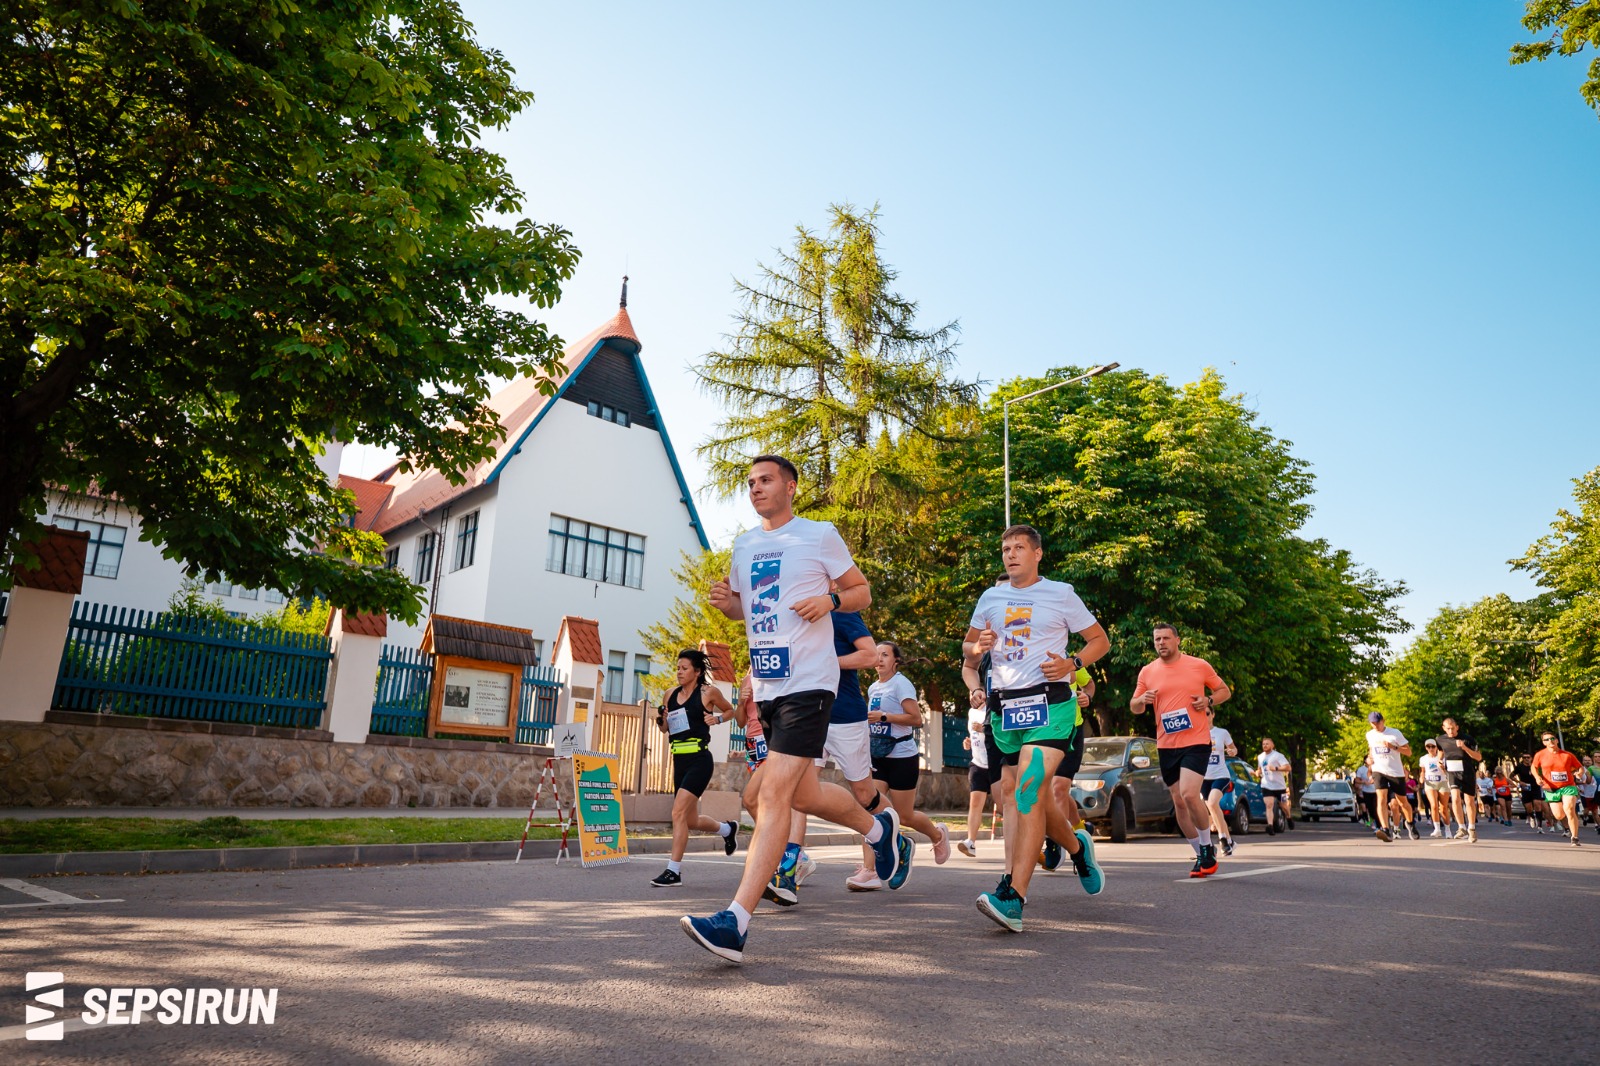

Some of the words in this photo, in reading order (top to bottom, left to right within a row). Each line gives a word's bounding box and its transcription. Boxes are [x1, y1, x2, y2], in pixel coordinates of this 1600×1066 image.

[753, 551, 784, 560] SEPSIRUN
[752, 654, 781, 670] 1158
[1010, 710, 1040, 724] 1051
[870, 725, 888, 735] 1097
[1164, 718, 1188, 730] 1064
